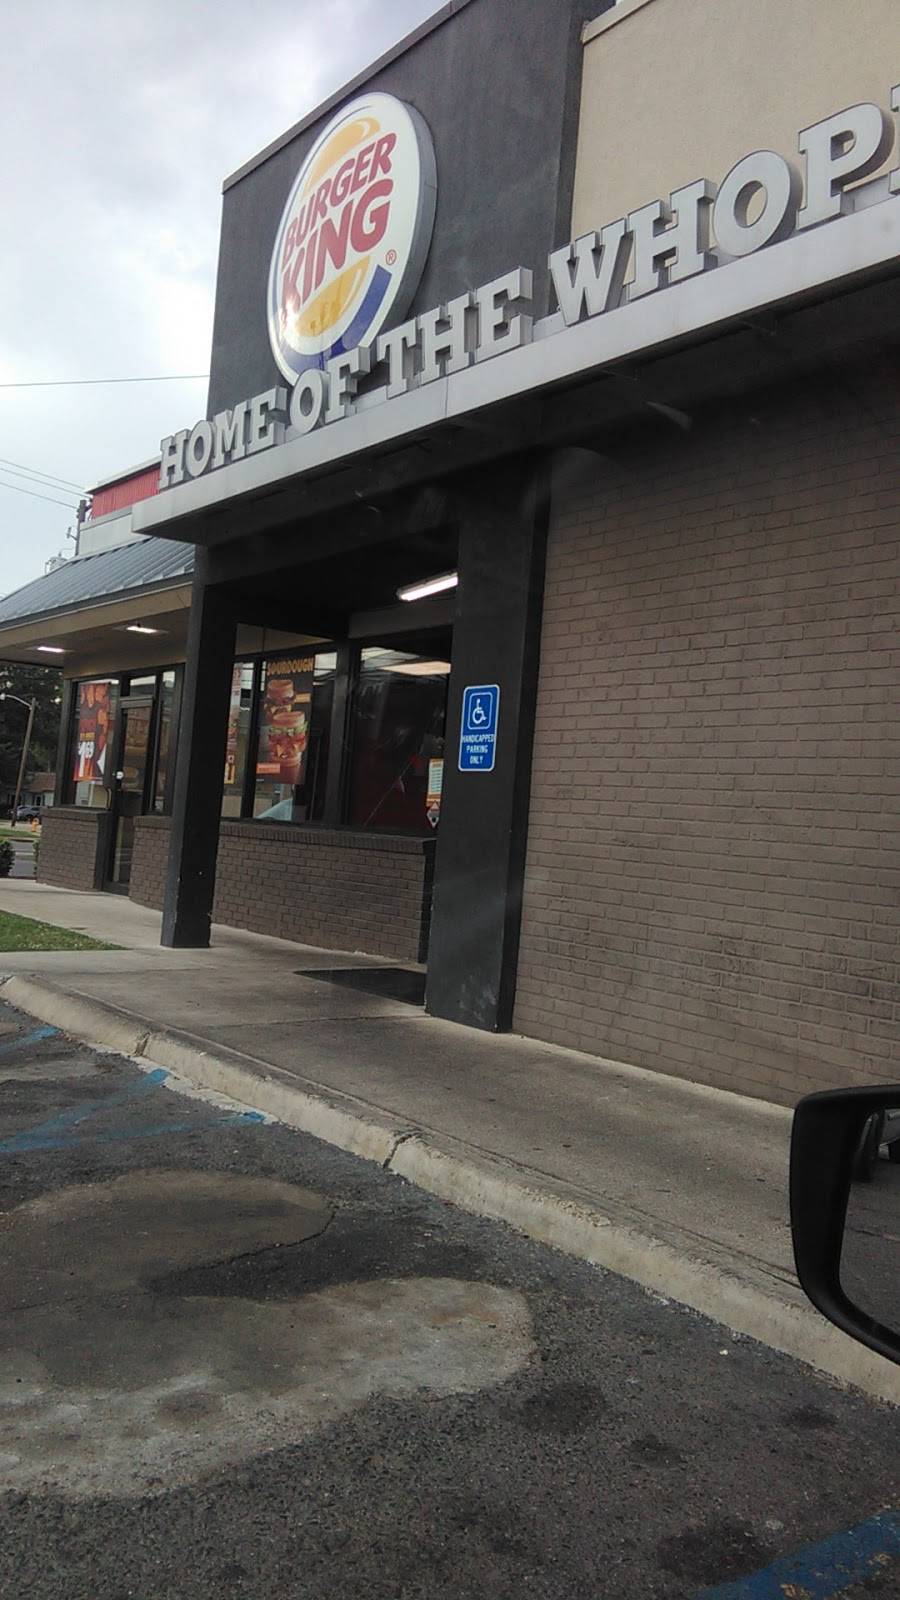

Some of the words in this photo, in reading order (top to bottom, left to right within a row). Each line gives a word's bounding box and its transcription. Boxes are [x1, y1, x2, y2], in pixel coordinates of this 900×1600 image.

[282, 132, 397, 272] BURGER
[281, 178, 394, 326] KING
[158, 385, 287, 488] HOME
[290, 342, 370, 435] OF
[376, 266, 533, 400] THE
[548, 83, 900, 327] WHOP
[266, 657, 314, 676] SOURDOUGH
[461, 733, 494, 744] HANDICAPPED
[466, 744, 489, 754] PARKING
[469, 755, 484, 765] ONLY
